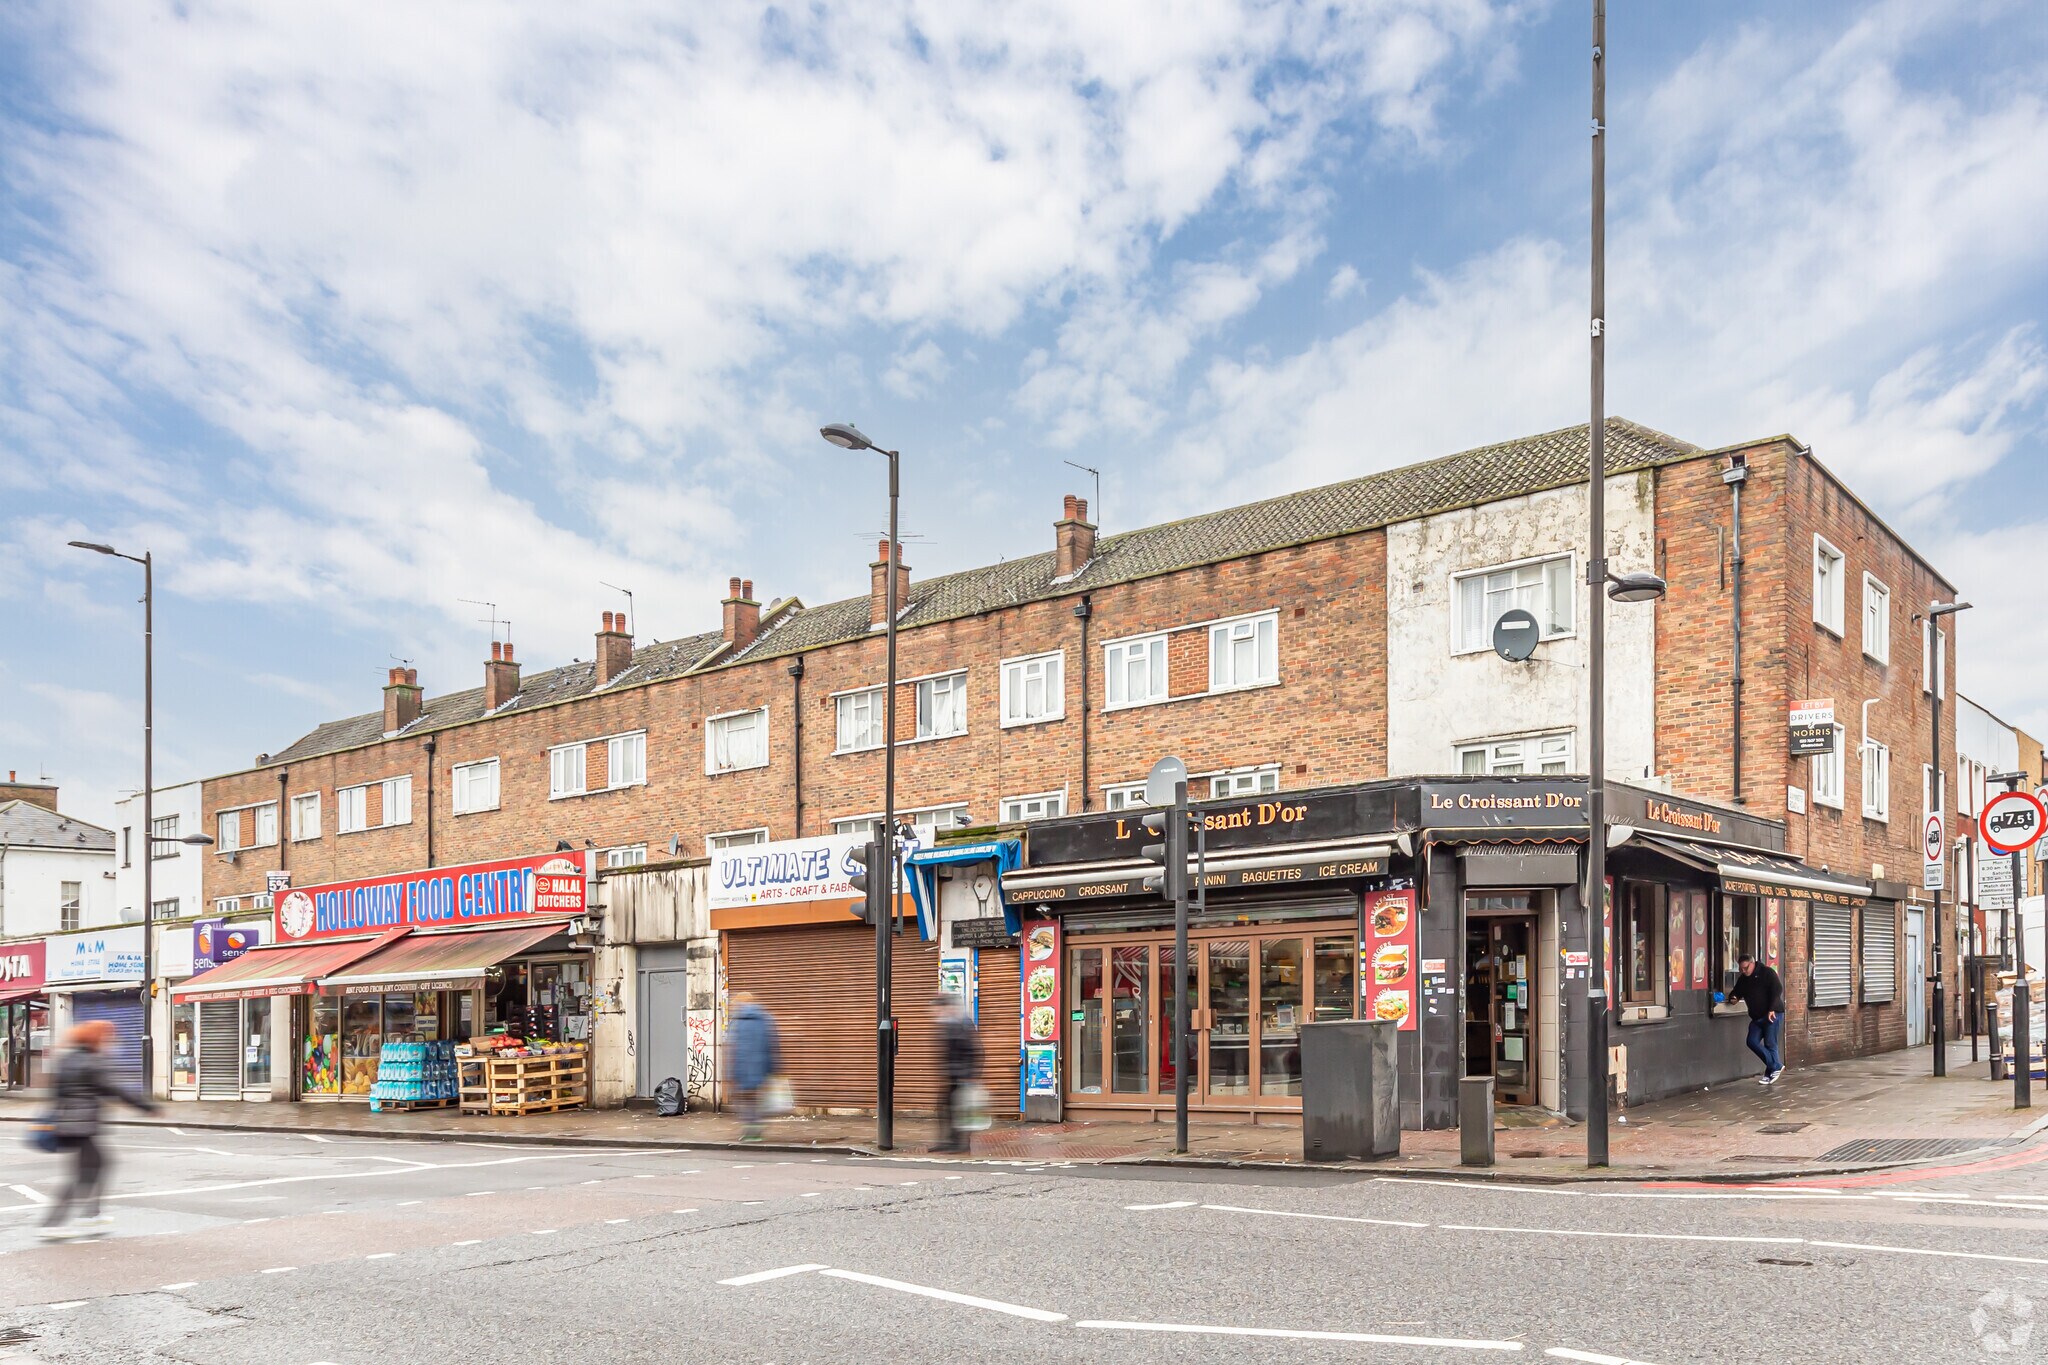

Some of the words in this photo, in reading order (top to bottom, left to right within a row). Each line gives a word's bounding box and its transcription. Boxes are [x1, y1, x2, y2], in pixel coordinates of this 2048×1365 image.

[1791, 712, 1833, 721] DRIVERS
[1793, 728, 1831, 737] NORRIS
[1431, 794, 1453, 809] Le
[1459, 793, 1541, 808] Croissant
[1545, 793, 1582, 808] D'or
[1257, 802, 1307, 825] D'or
[1647, 799, 1660, 820] Le
[1661, 802, 1703, 831] Croissant
[1703, 812, 1721, 834] D'or
[720, 848, 830, 889] ULTIMATE
[268, 880, 289, 891] 5%
[552, 879, 582, 893] HALAL
[1012, 888, 1066, 902] CAPPUCCINO
[1078, 883, 1129, 897] CROISSANT
[1241, 868, 1302, 883] BAGUETTES
[1319, 865, 1336, 877] ICE
[1339, 861, 1378, 874] CREAM
[759, 889, 783, 900] ARTS
[789, 884, 818, 897] CRAFT
[821, 884, 827, 893] &
[315, 883, 402, 932] HOLLOWAY
[406, 878, 453, 923] FOOD
[537, 895, 582, 908] BUTCHERS
[1370, 893, 1395, 924] BREAKFAST
[76, 942, 85, 955] M
[95, 940, 105, 953] M
[0, 955, 31, 982] STA
